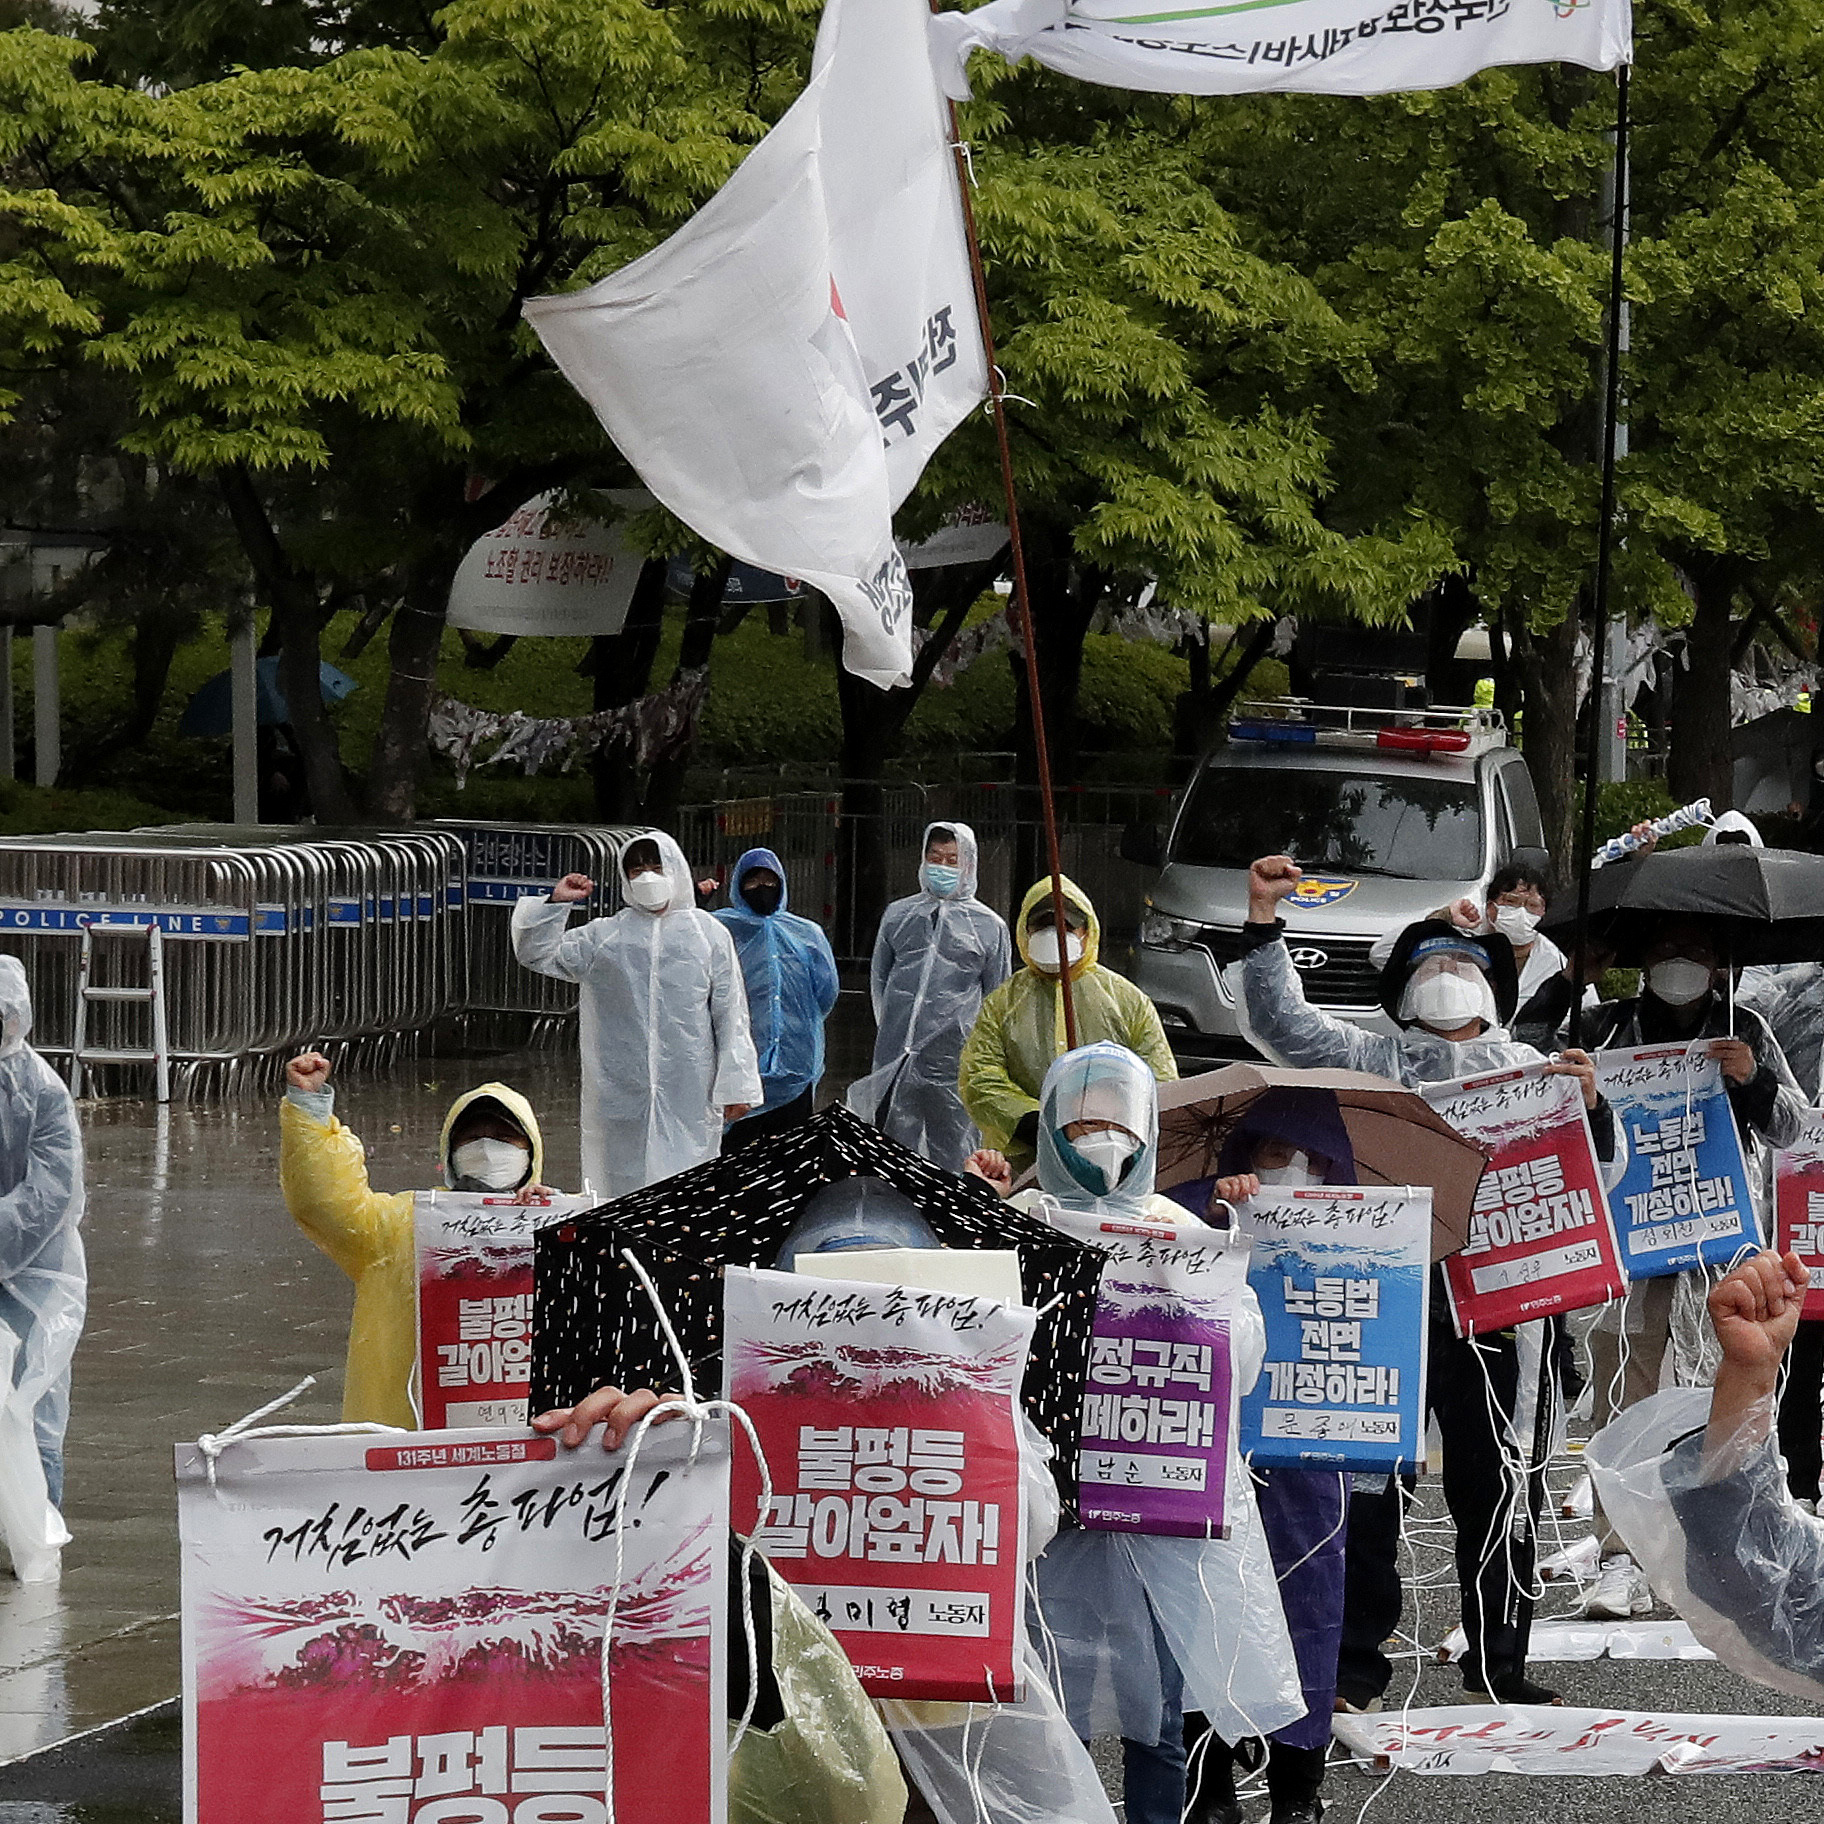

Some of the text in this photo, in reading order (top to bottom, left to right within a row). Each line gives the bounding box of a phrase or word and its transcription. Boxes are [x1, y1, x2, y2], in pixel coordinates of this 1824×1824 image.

[1632, 1111, 1706, 1156] 노동법
[1650, 1153, 1700, 1187] 전면
[1253, 1204, 1320, 1231] 거침없는
[1623, 1176, 1734, 1227] 개정하라!
[458, 1294, 534, 1341] 불평
[771, 1290, 878, 1328] 거침없는
[1283, 1274, 1381, 1320] 노동법
[1084, 1335, 1213, 1392] 정규직
[1300, 1320, 1363, 1363] 전면
[1262, 1360, 1401, 1407] 개정하라!
[1080, 1392, 1216, 1448] 폐하라!
[1359, 1418, 1398, 1436] 노동자
[395, 1442, 527, 1471] 131주년 세계노동절
[797, 1423, 966, 1497] 불평등
[1160, 1464, 1203, 1484] 노동자
[262, 1499, 449, 1571] 거침없는
[757, 1491, 1001, 1567] 갈아엎자!
[927, 1603, 987, 1626] 노동자
